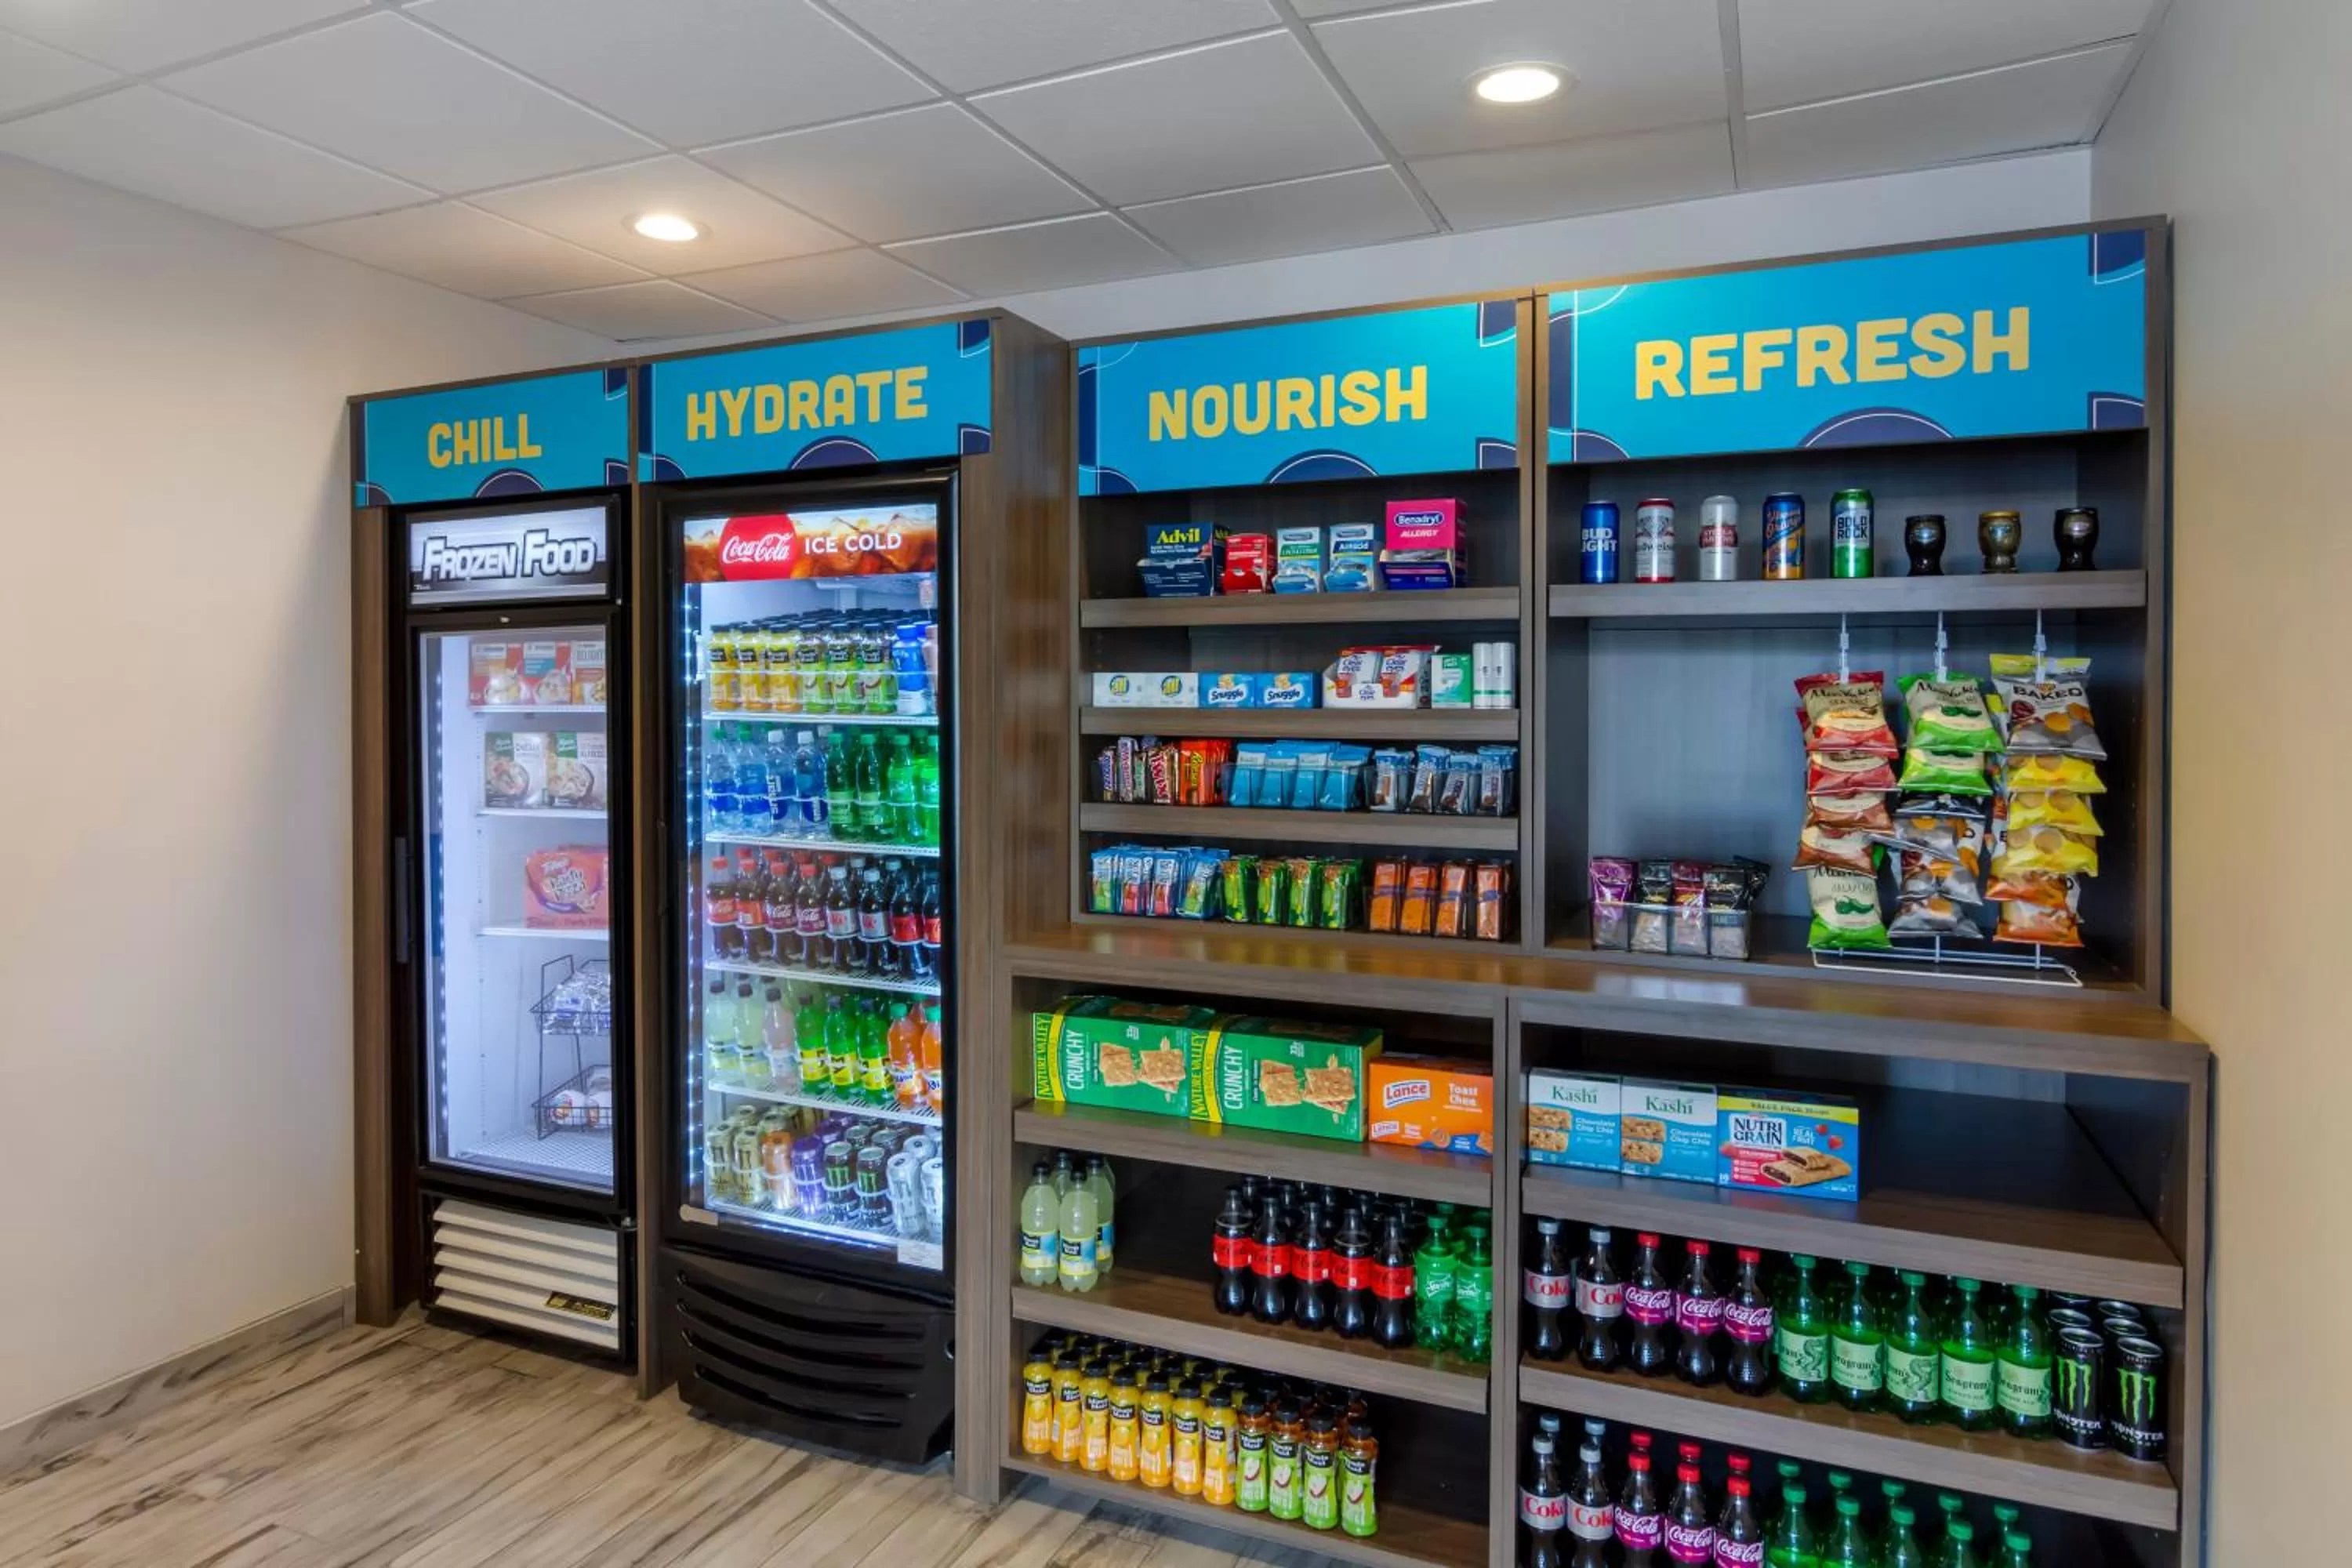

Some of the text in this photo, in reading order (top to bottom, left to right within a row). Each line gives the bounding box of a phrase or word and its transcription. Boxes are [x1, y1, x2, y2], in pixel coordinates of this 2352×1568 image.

[1635, 307, 2030, 400] REFRESH
[686, 366, 928, 441] HYDRATE
[1149, 365, 1428, 441] NOURISH
[427, 413, 543, 468] CHILL
[1837, 515, 1867, 528] BOLD
[805, 532, 902, 554] ICE COLD
[1156, 528, 1201, 544] Advil
[1582, 527, 1613, 540] BUD
[1837, 527, 1868, 540] ROCK
[423, 528, 598, 583] FROZEN FOOD
[722, 532, 794, 564] Coca-Cola
[1211, 688, 1244, 701] Snuggle
[1267, 688, 1301, 701] Snuggle
[2013, 685, 2083, 701] BAKED
[1150, 752, 1168, 798] TWIX
[1066, 1029, 1084, 1090] CRUNCHY
[1224, 1044, 1243, 1109] CRUNCHY
[1385, 1083, 1428, 1101] Lance
[1552, 1084, 1598, 1105] Kashi
[1646, 1095, 1694, 1115] Kashi
[1734, 1118, 1782, 1133] NUTRI
[1733, 1131, 1782, 1145] GRAIN
[1626, 1287, 1672, 1309] Coca-Cola
[1725, 1302, 1773, 1327] Coca-Cola
